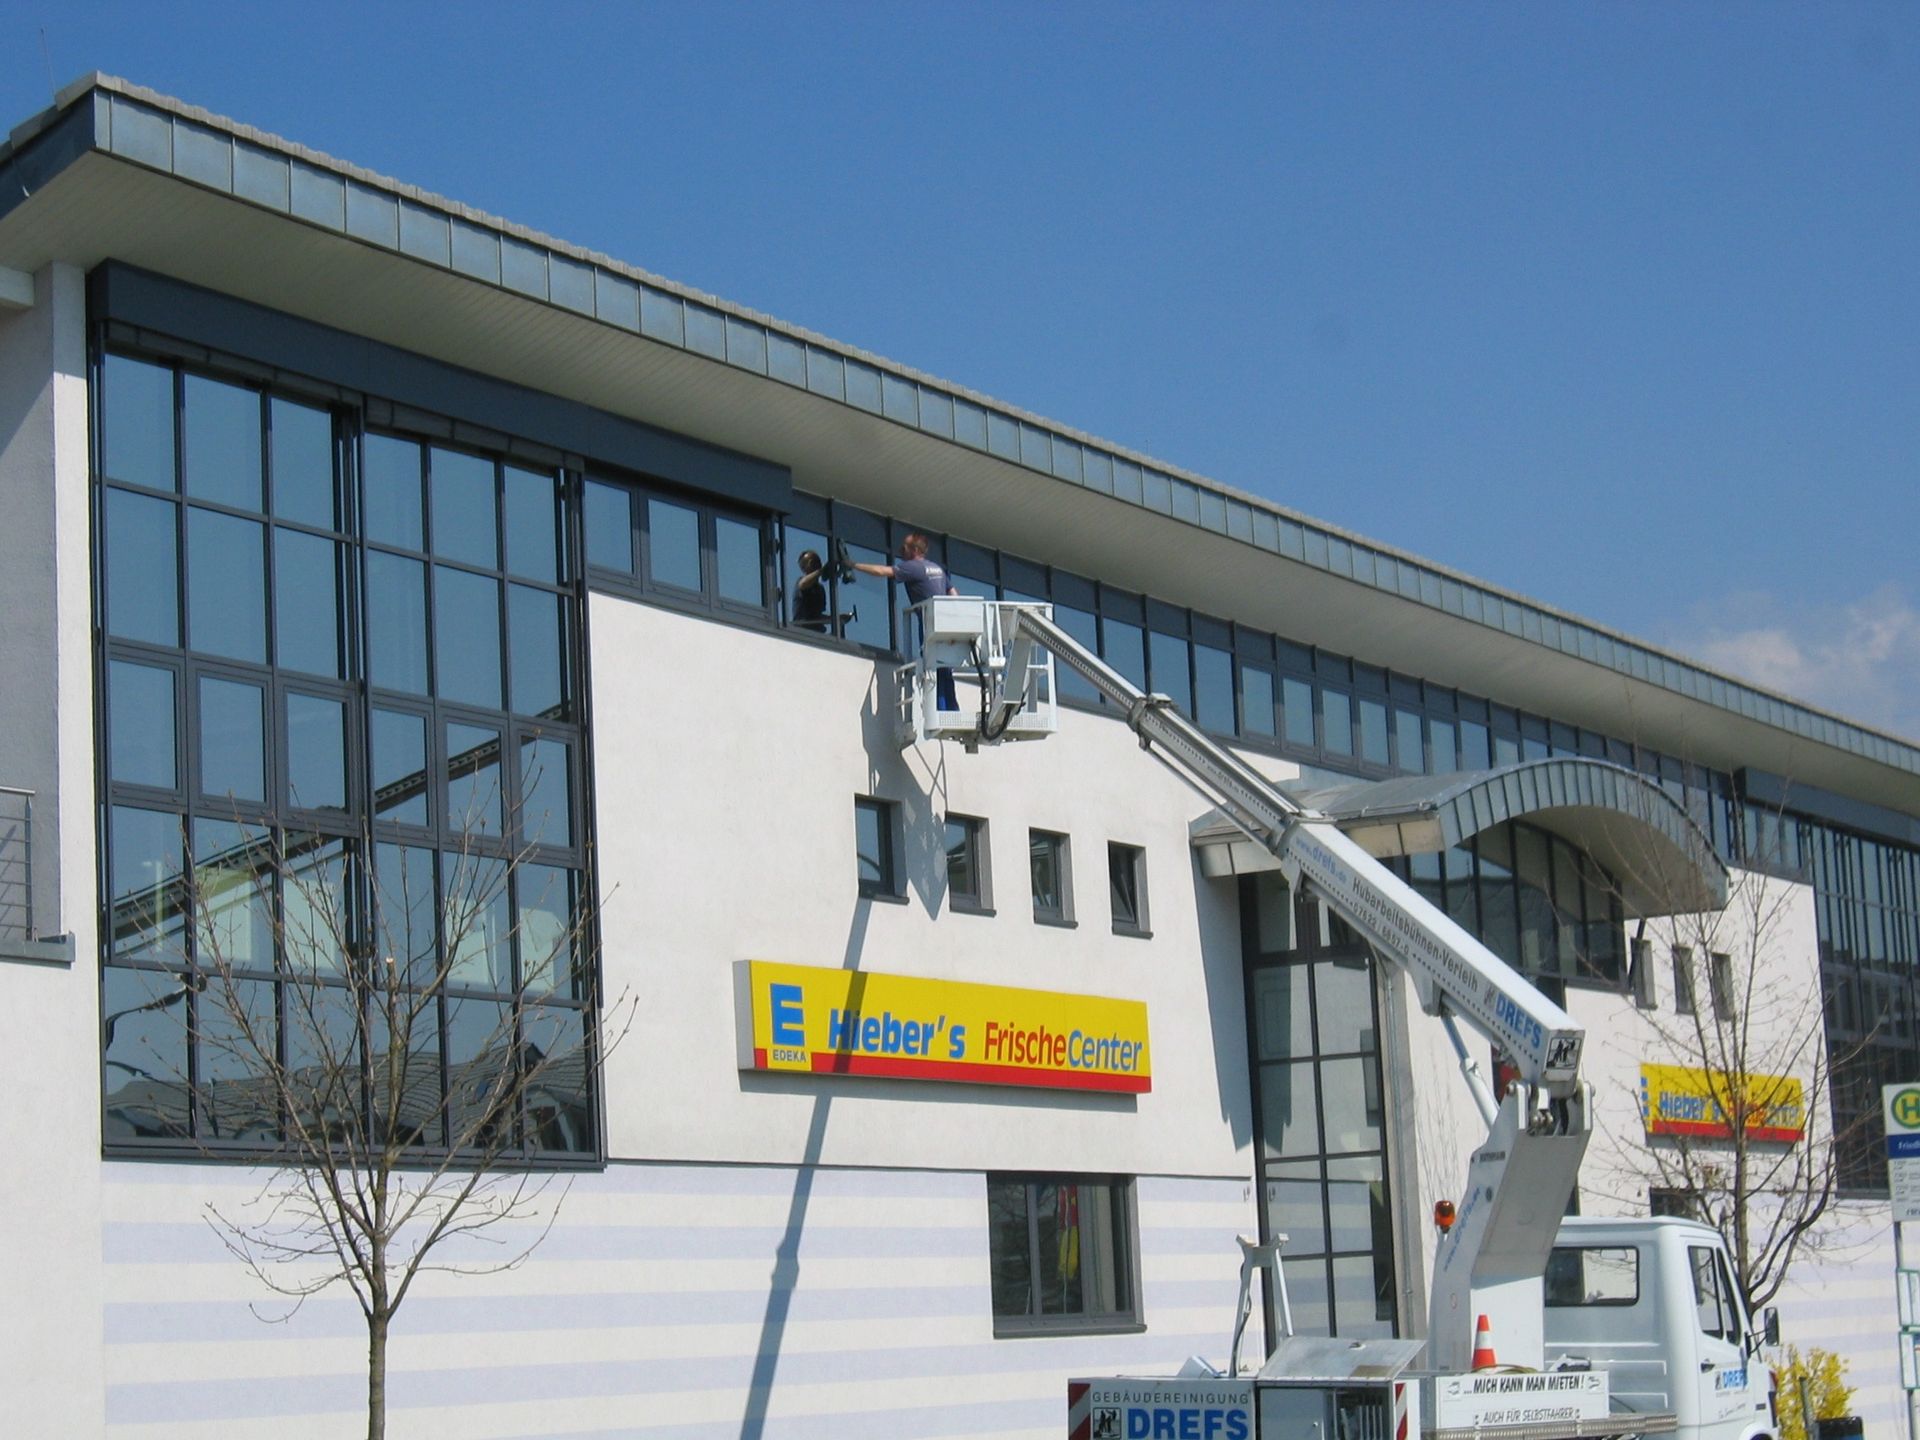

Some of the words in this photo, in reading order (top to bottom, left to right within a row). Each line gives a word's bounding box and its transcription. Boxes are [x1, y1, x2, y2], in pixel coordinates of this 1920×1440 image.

[1352, 876, 1479, 993] Hubarbeitsbühnen-Verleih
[769, 982, 806, 1047] E
[1495, 991, 1542, 1050] DREFS
[772, 1049, 807, 1062] EDEKA
[828, 1008, 966, 1059] Hieber's
[984, 1021, 1143, 1071] FrischeCenter
[1092, 1391, 1249, 1405] GEBÄUDEREINIGUNG
[1500, 1377, 1524, 1393] KANN
[1525, 1376, 1546, 1392] MAN
[1127, 1408, 1249, 1440] DREFS
[1483, 1411, 1505, 1423] AUCH
[1505, 1409, 1521, 1422] FÜR
[1522, 1407, 1575, 1421] SELBSTFAHRER
